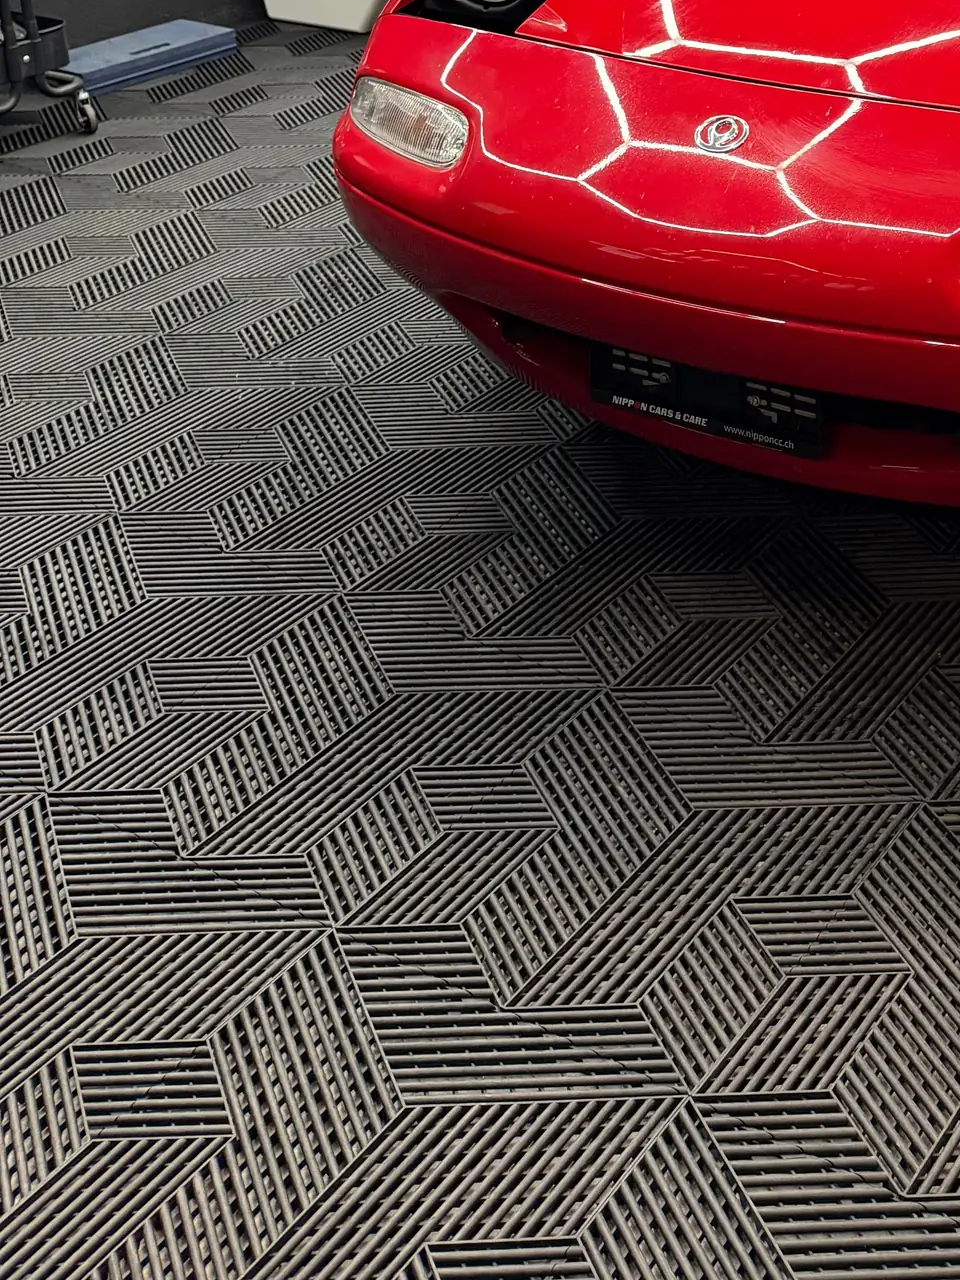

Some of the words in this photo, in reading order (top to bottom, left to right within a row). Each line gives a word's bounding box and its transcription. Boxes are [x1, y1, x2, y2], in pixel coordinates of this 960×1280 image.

[612, 395, 648, 412] NIPPON
[648, 405, 674, 418] CARS
[675, 411, 682, 420] &
[682, 414, 708, 427] CARE
[723, 424, 795, 450] www.nipponcc.ch
